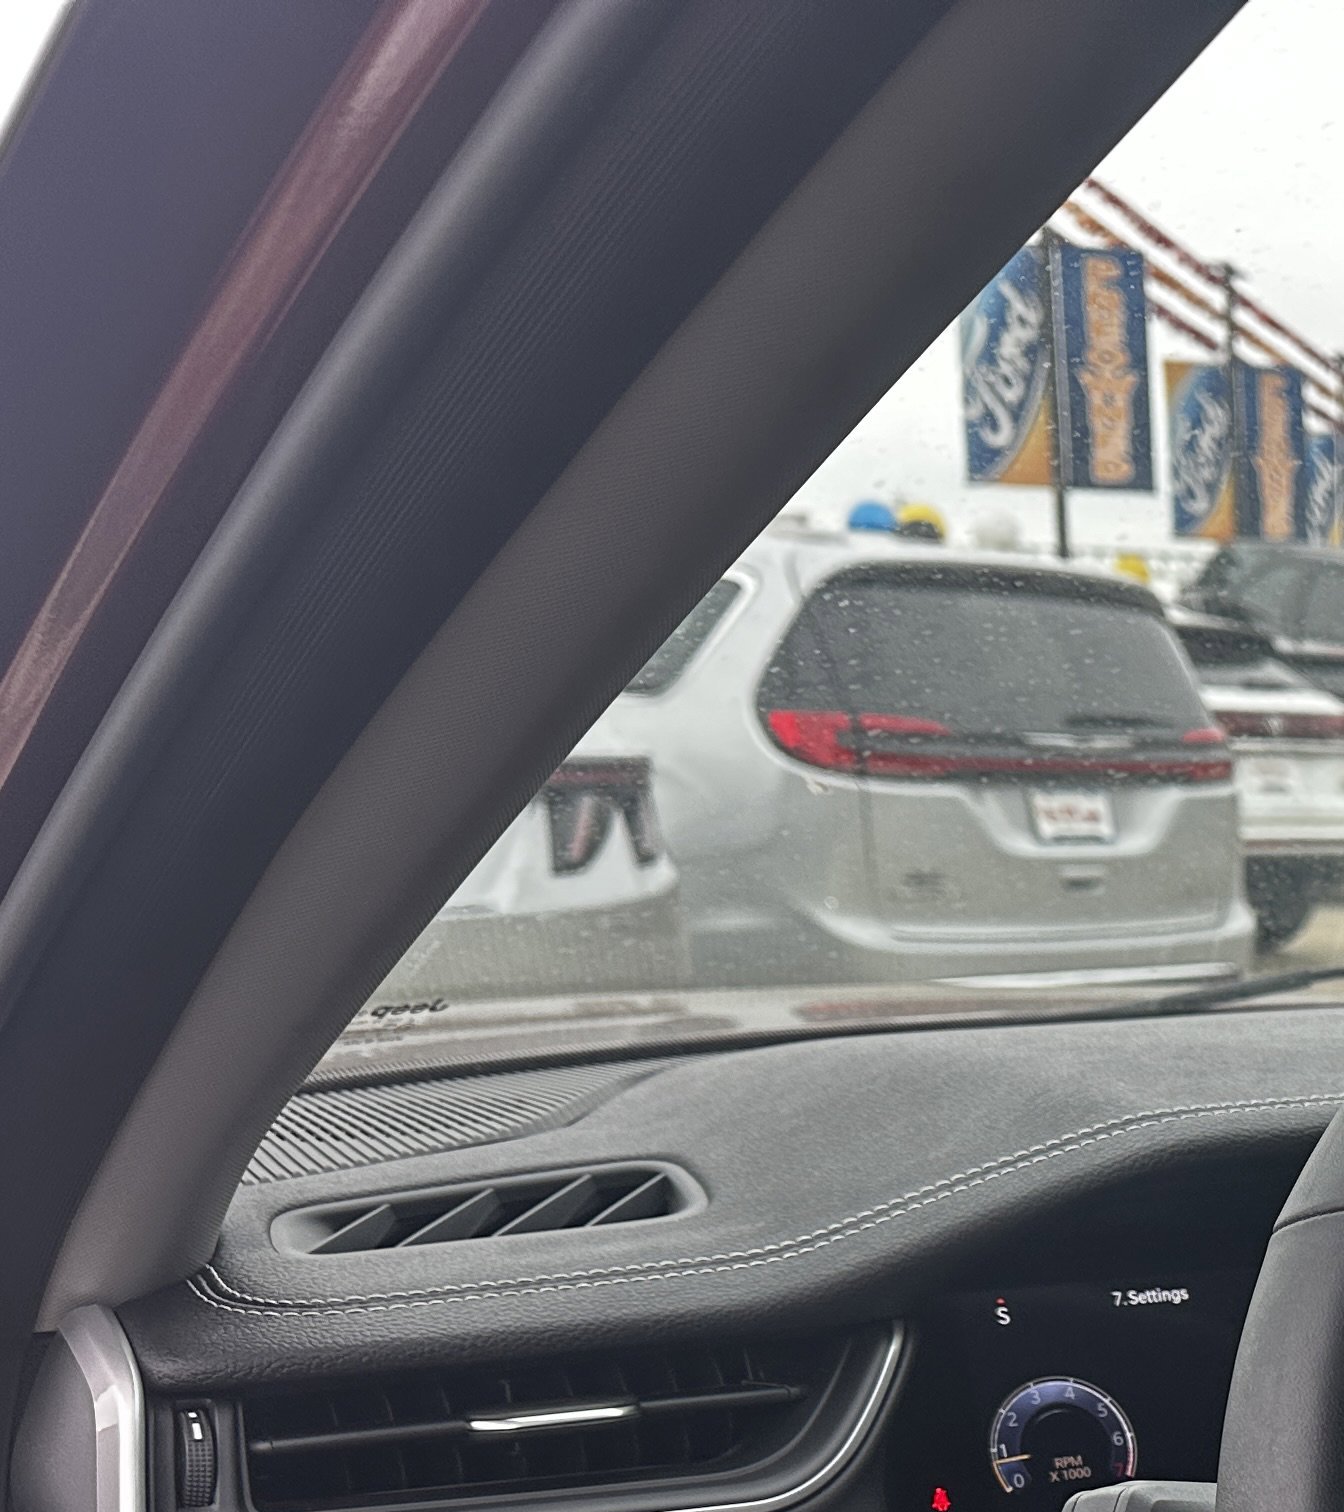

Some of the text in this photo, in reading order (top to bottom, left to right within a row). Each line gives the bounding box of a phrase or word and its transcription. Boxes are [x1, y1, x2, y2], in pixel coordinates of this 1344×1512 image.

[995, 1306, 1011, 1325] S
[1030, 1390, 1042, 1405] 3
[1064, 1386, 1076, 1400] 4
[1097, 1402, 1109, 1417] 5
[1007, 1412, 1019, 1427] 2
[1112, 1431, 1124, 1446] 6
[999, 1443, 1008, 1457] 1
[1053, 1455, 1083, 1469] RPM
[1012, 1473, 1026, 1488] 0
[1061, 1466, 1092, 1481] 1000
